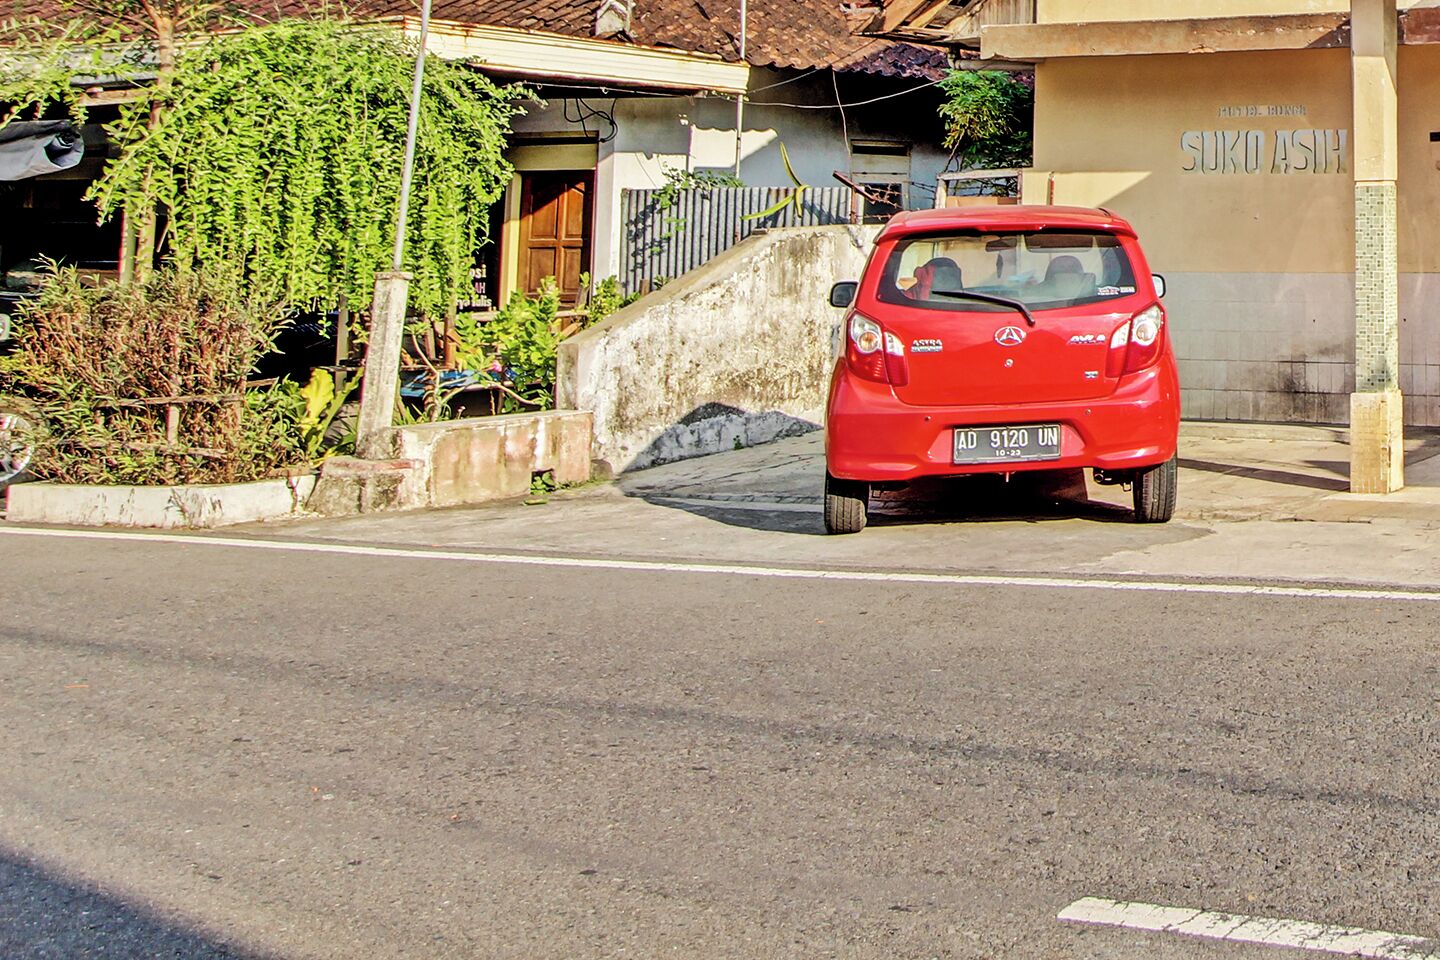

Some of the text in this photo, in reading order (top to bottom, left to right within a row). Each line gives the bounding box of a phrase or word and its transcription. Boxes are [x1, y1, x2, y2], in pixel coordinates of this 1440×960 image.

[1180, 129, 1348, 175] SUKO ASIH
[958, 427, 1058, 449] AD 9120 UN
